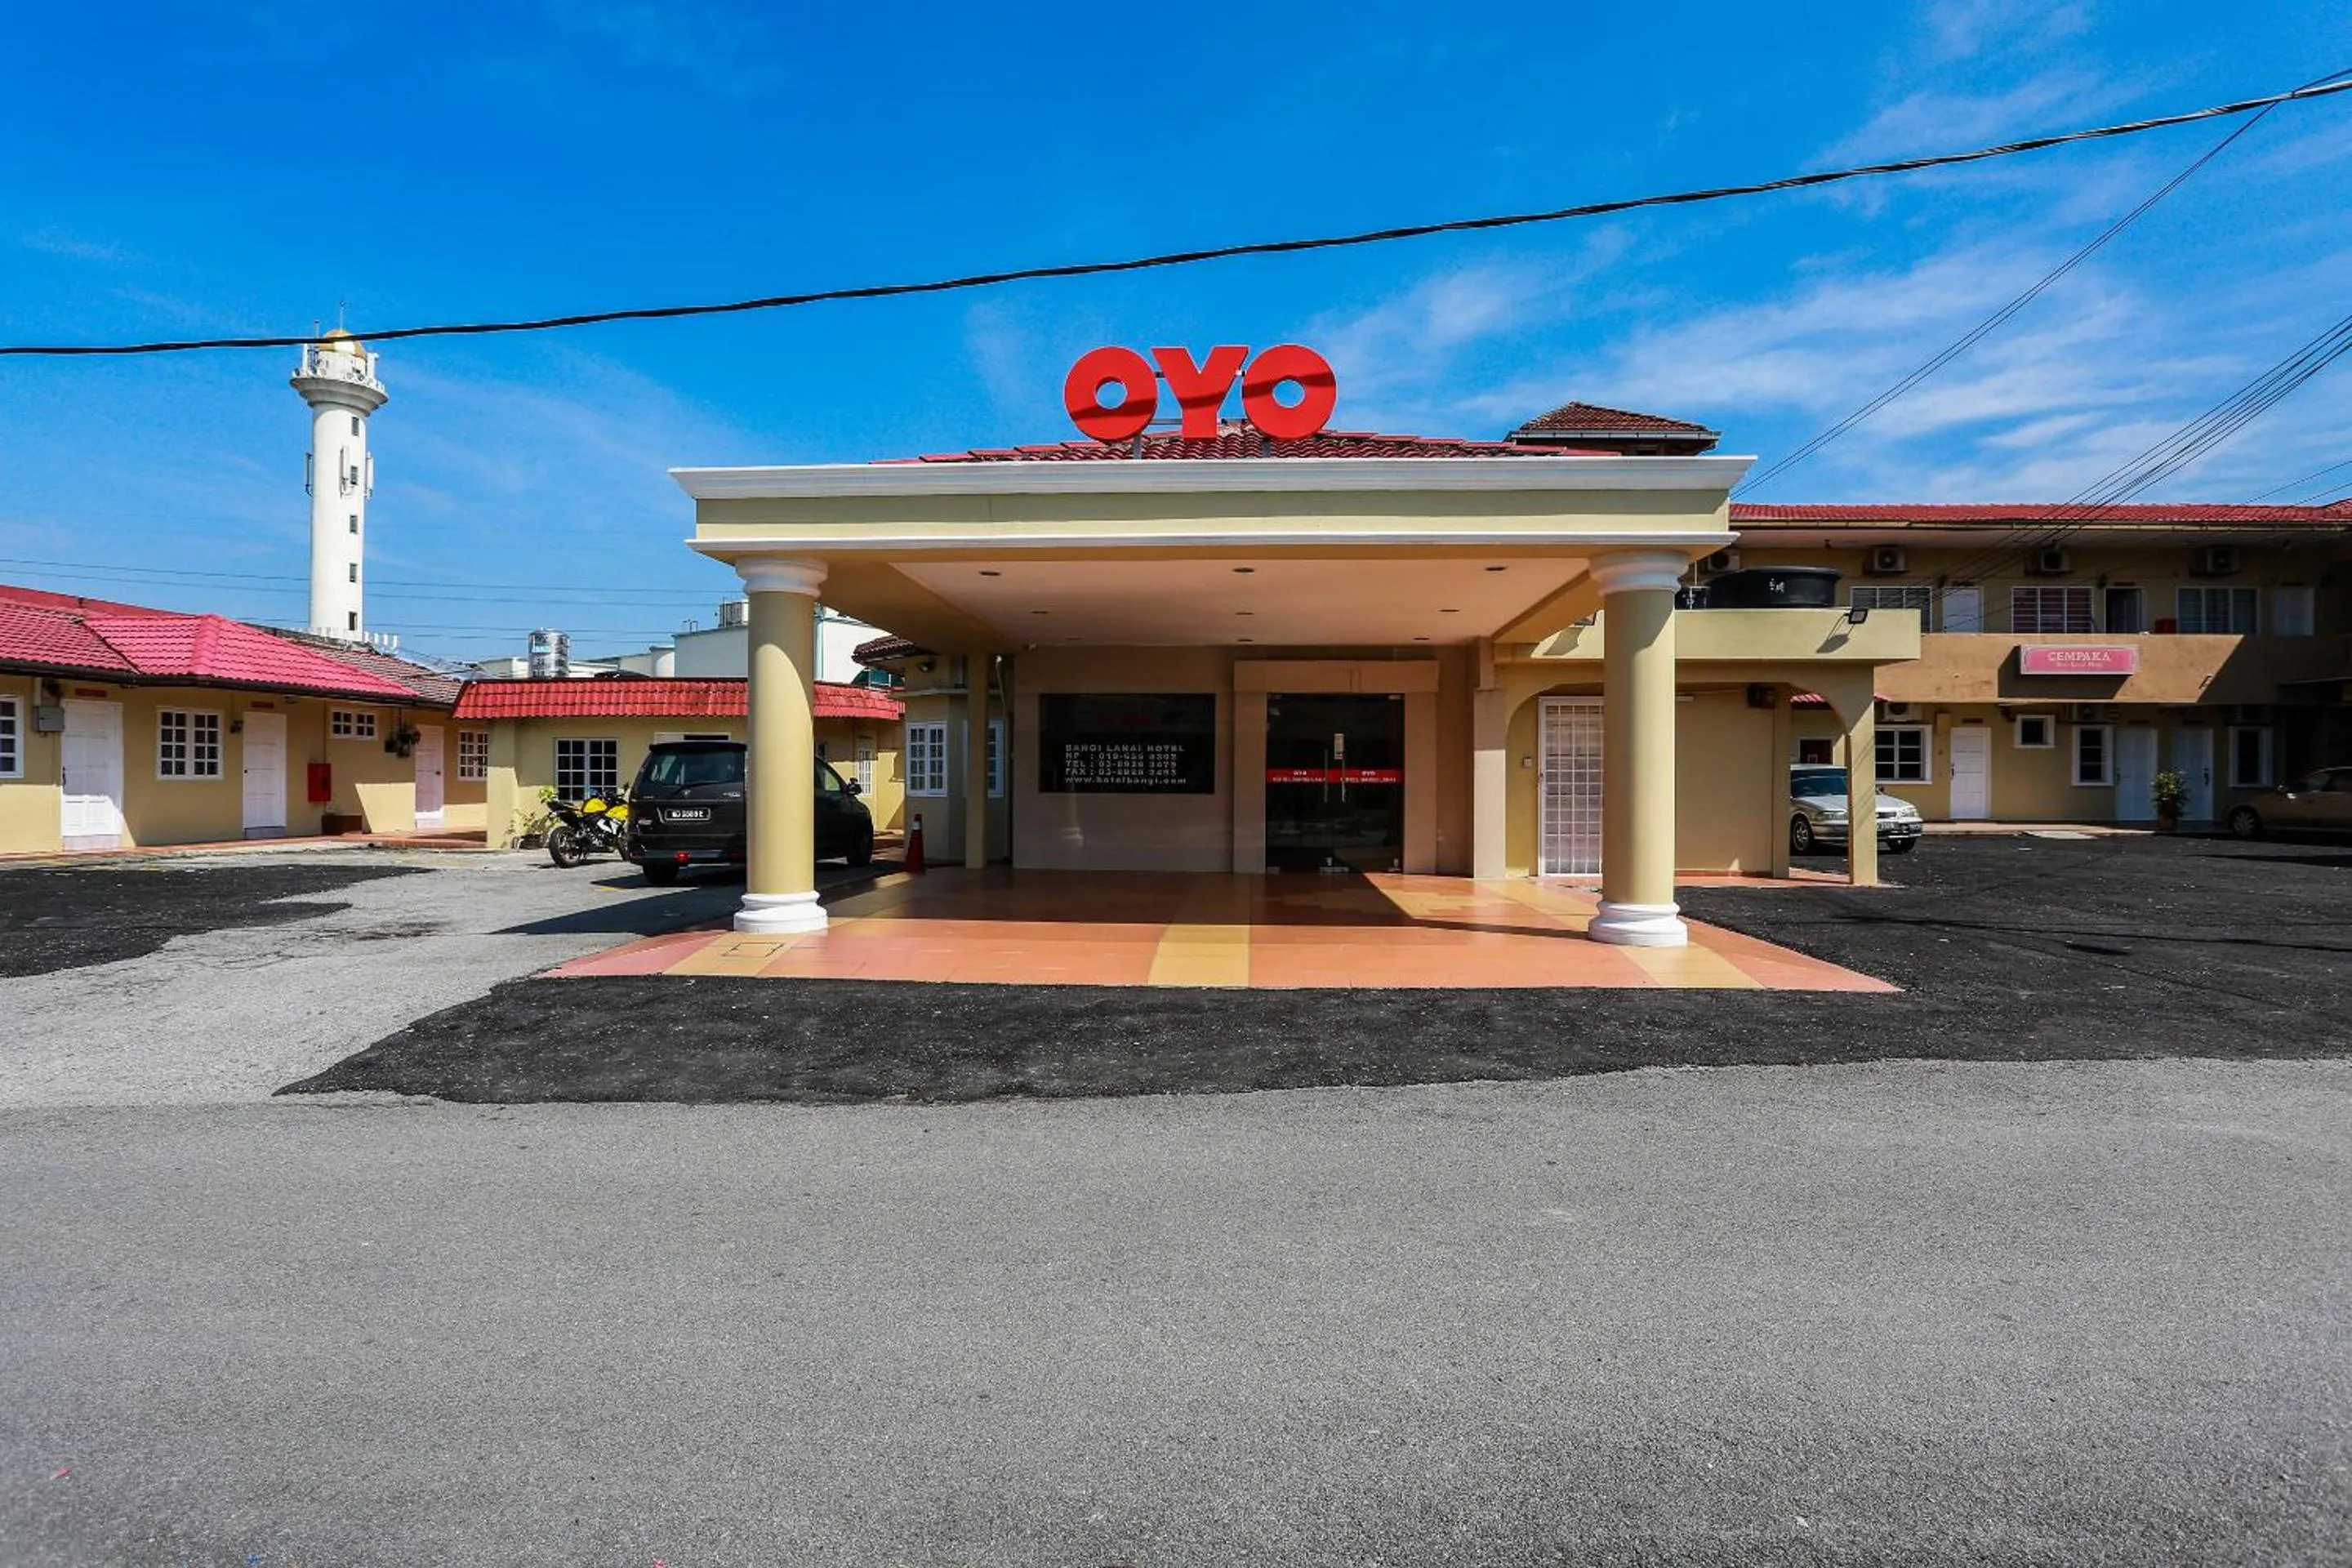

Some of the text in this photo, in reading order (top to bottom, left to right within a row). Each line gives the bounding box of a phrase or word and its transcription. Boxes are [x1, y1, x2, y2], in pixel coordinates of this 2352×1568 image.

[1063, 344, 1338, 442] OYO
[2047, 652, 2111, 662] CEMPAKA
[1065, 744, 1186, 752] BANGI LANAI HOTEL
[1065, 760, 1086, 768] TEL
[1065, 768, 1087, 776] FAX
[1064, 777, 1187, 785] www.hotelbangi.com
